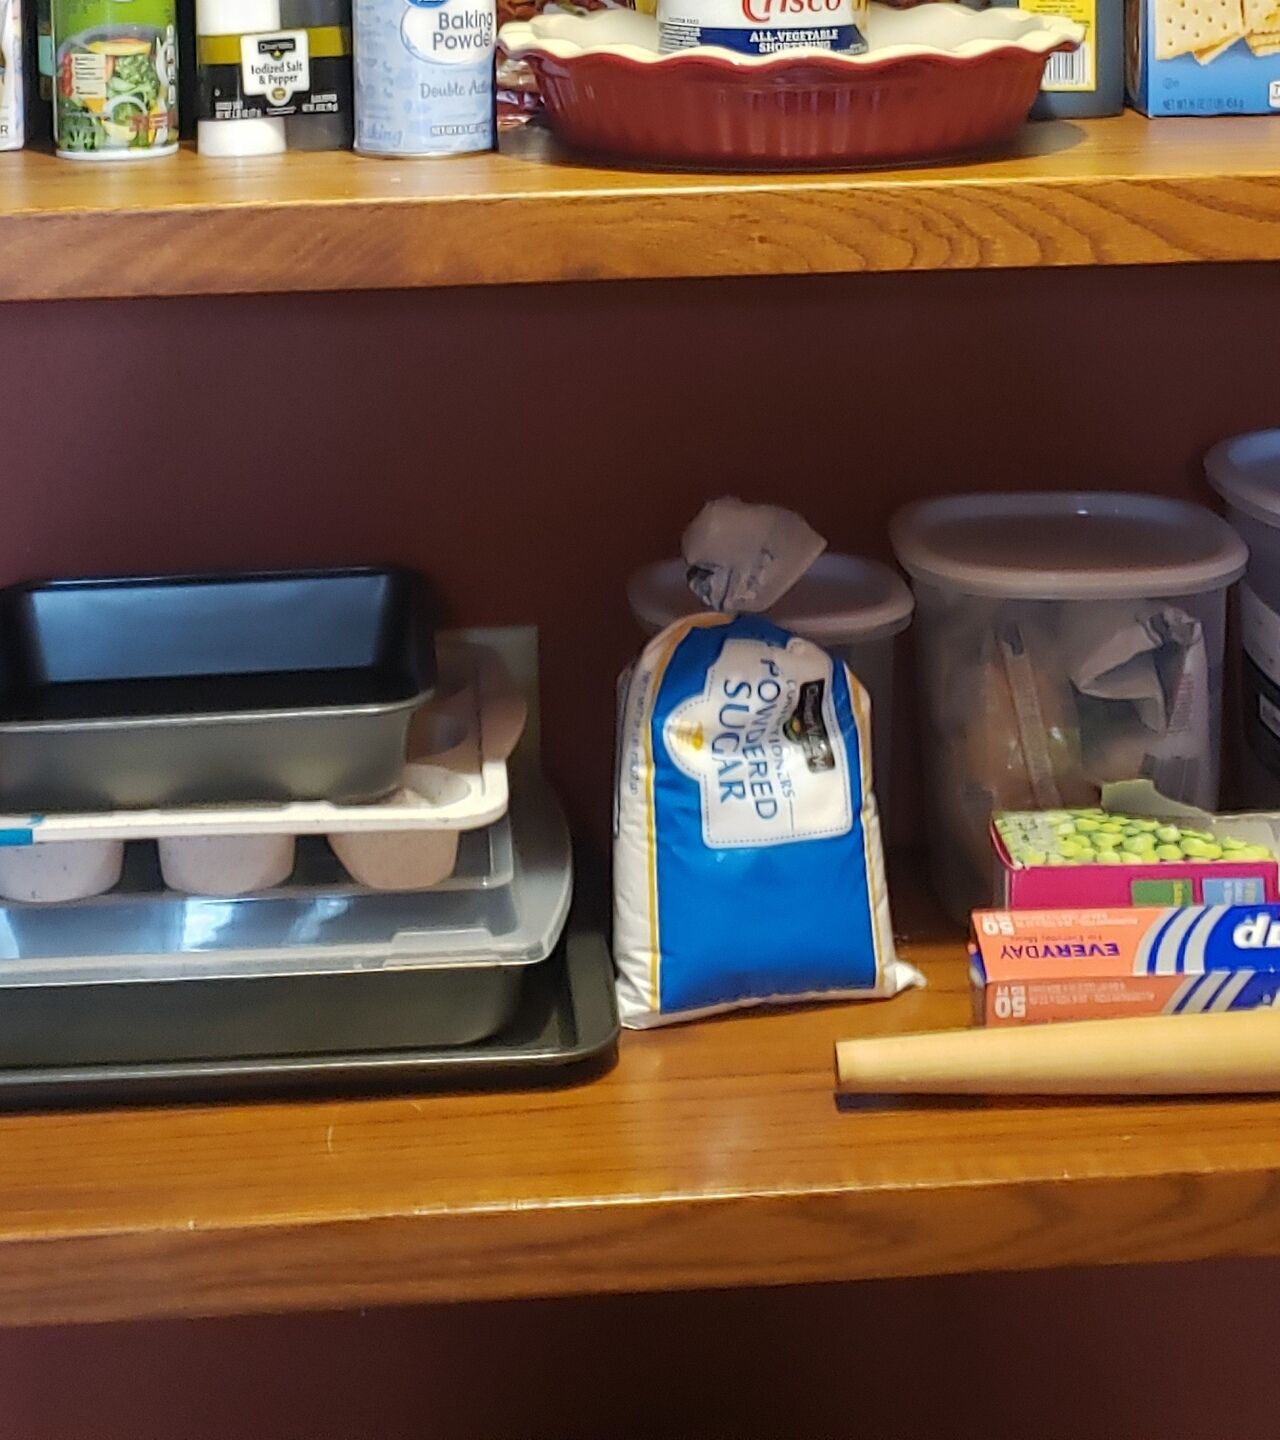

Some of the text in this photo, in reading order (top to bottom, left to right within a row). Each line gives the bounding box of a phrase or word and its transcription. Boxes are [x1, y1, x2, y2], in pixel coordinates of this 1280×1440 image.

[438, 10, 493, 32] Baking
[749, 29, 839, 44] ALL-VEGETABLE
[250, 61, 303, 75] Iodized Salt
[268, 74, 298, 86] Pepper
[420, 81, 465, 99] Double
[711, 678, 752, 804] SUGAR
[1001, 943, 1121, 961] EVERYDAY
[994, 994, 1027, 1018] 50
